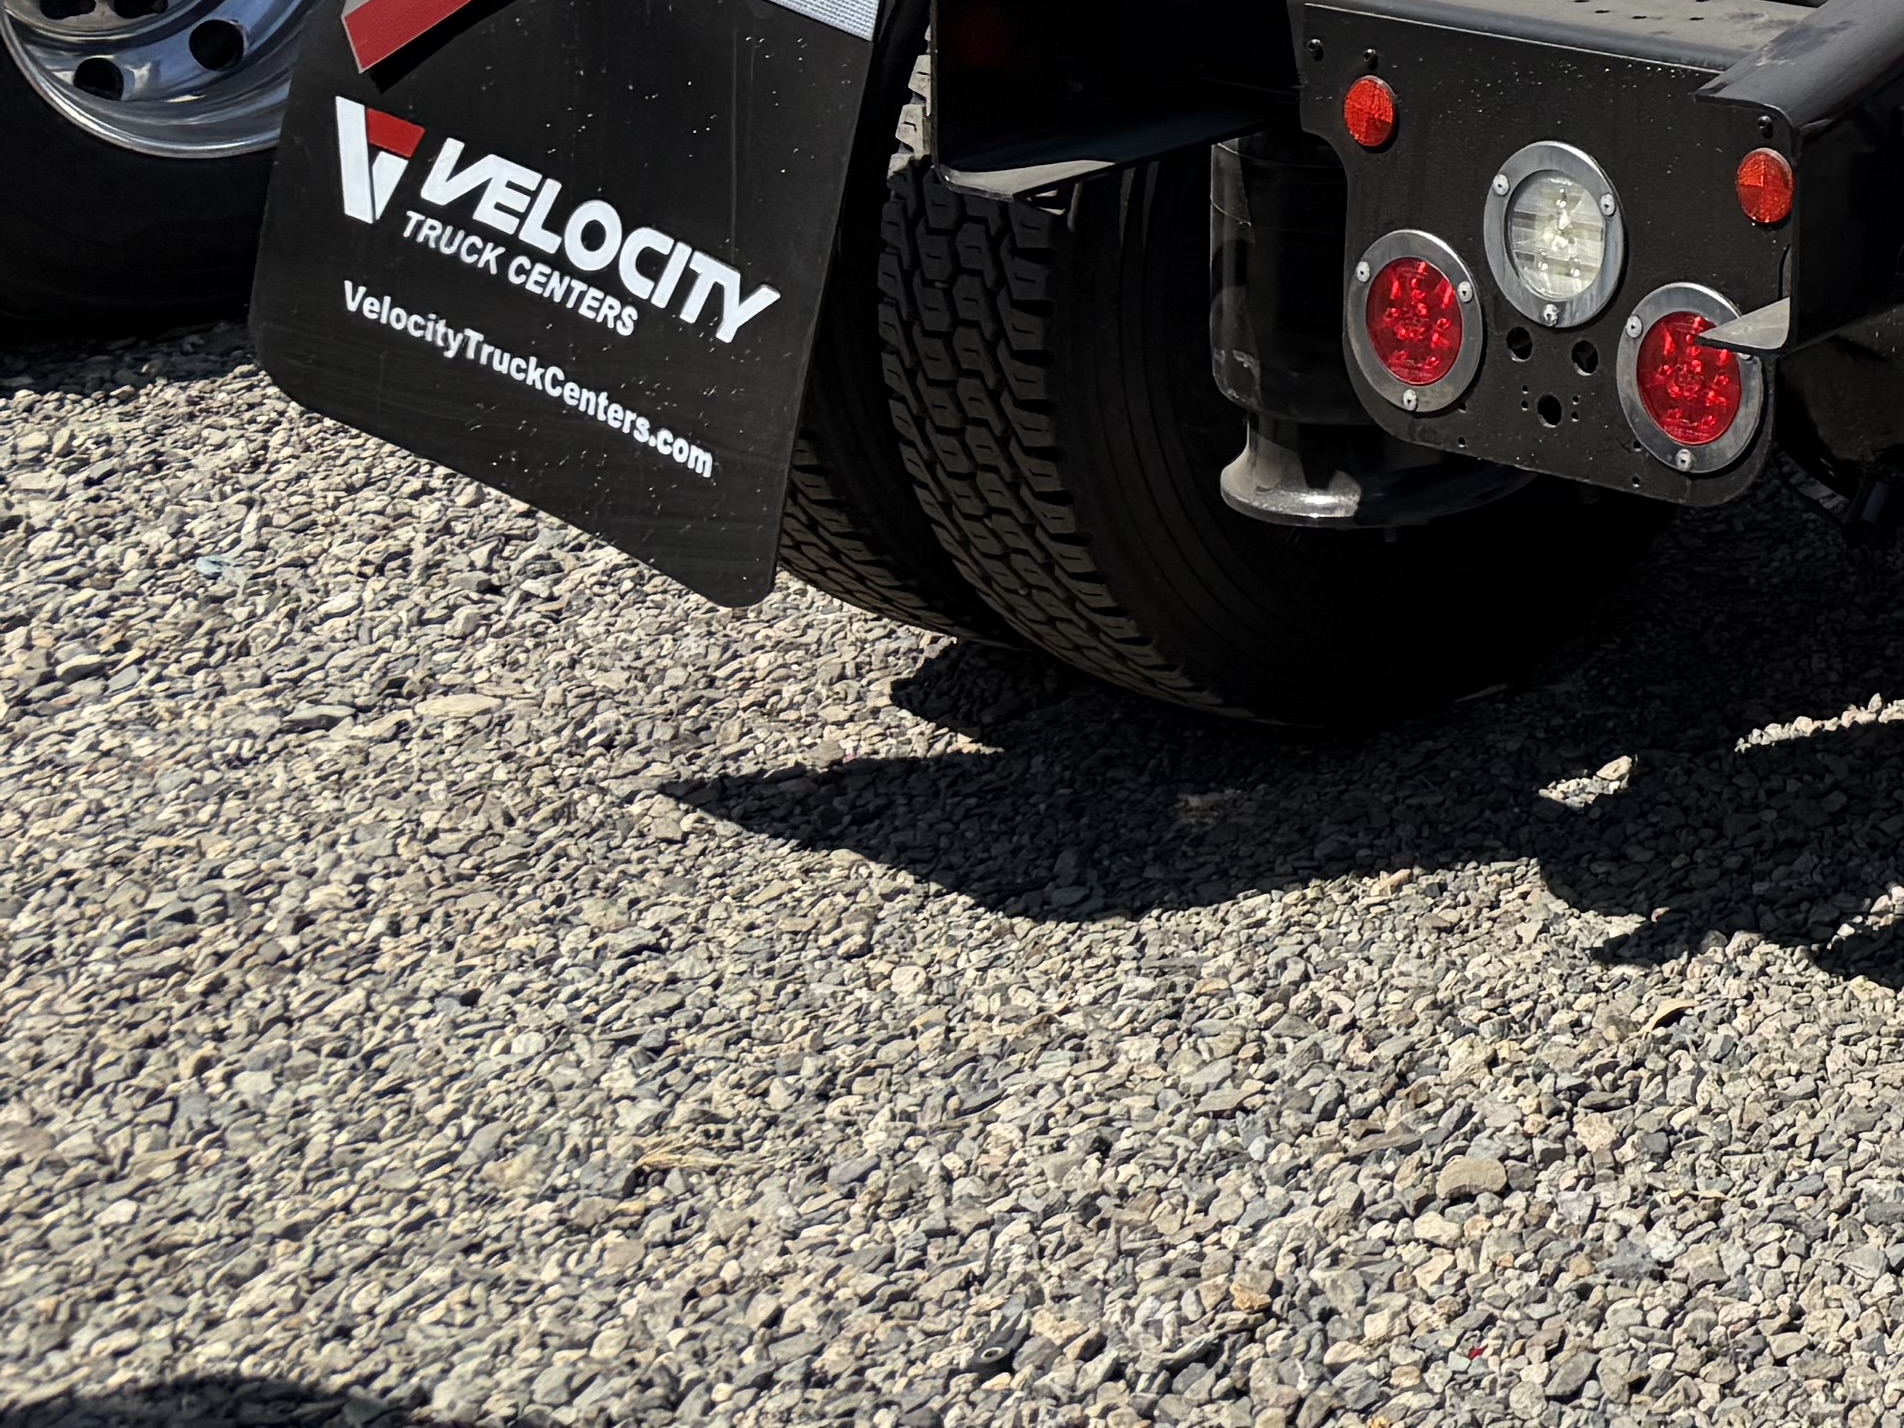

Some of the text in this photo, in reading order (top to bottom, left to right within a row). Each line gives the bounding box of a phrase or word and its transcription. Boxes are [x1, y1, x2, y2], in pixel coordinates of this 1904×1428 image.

[403, 210, 639, 337] TRUCK CENTERS
[421, 137, 780, 343] VELOCITY
[343, 279, 713, 478] VelocityTruckCenters.com
